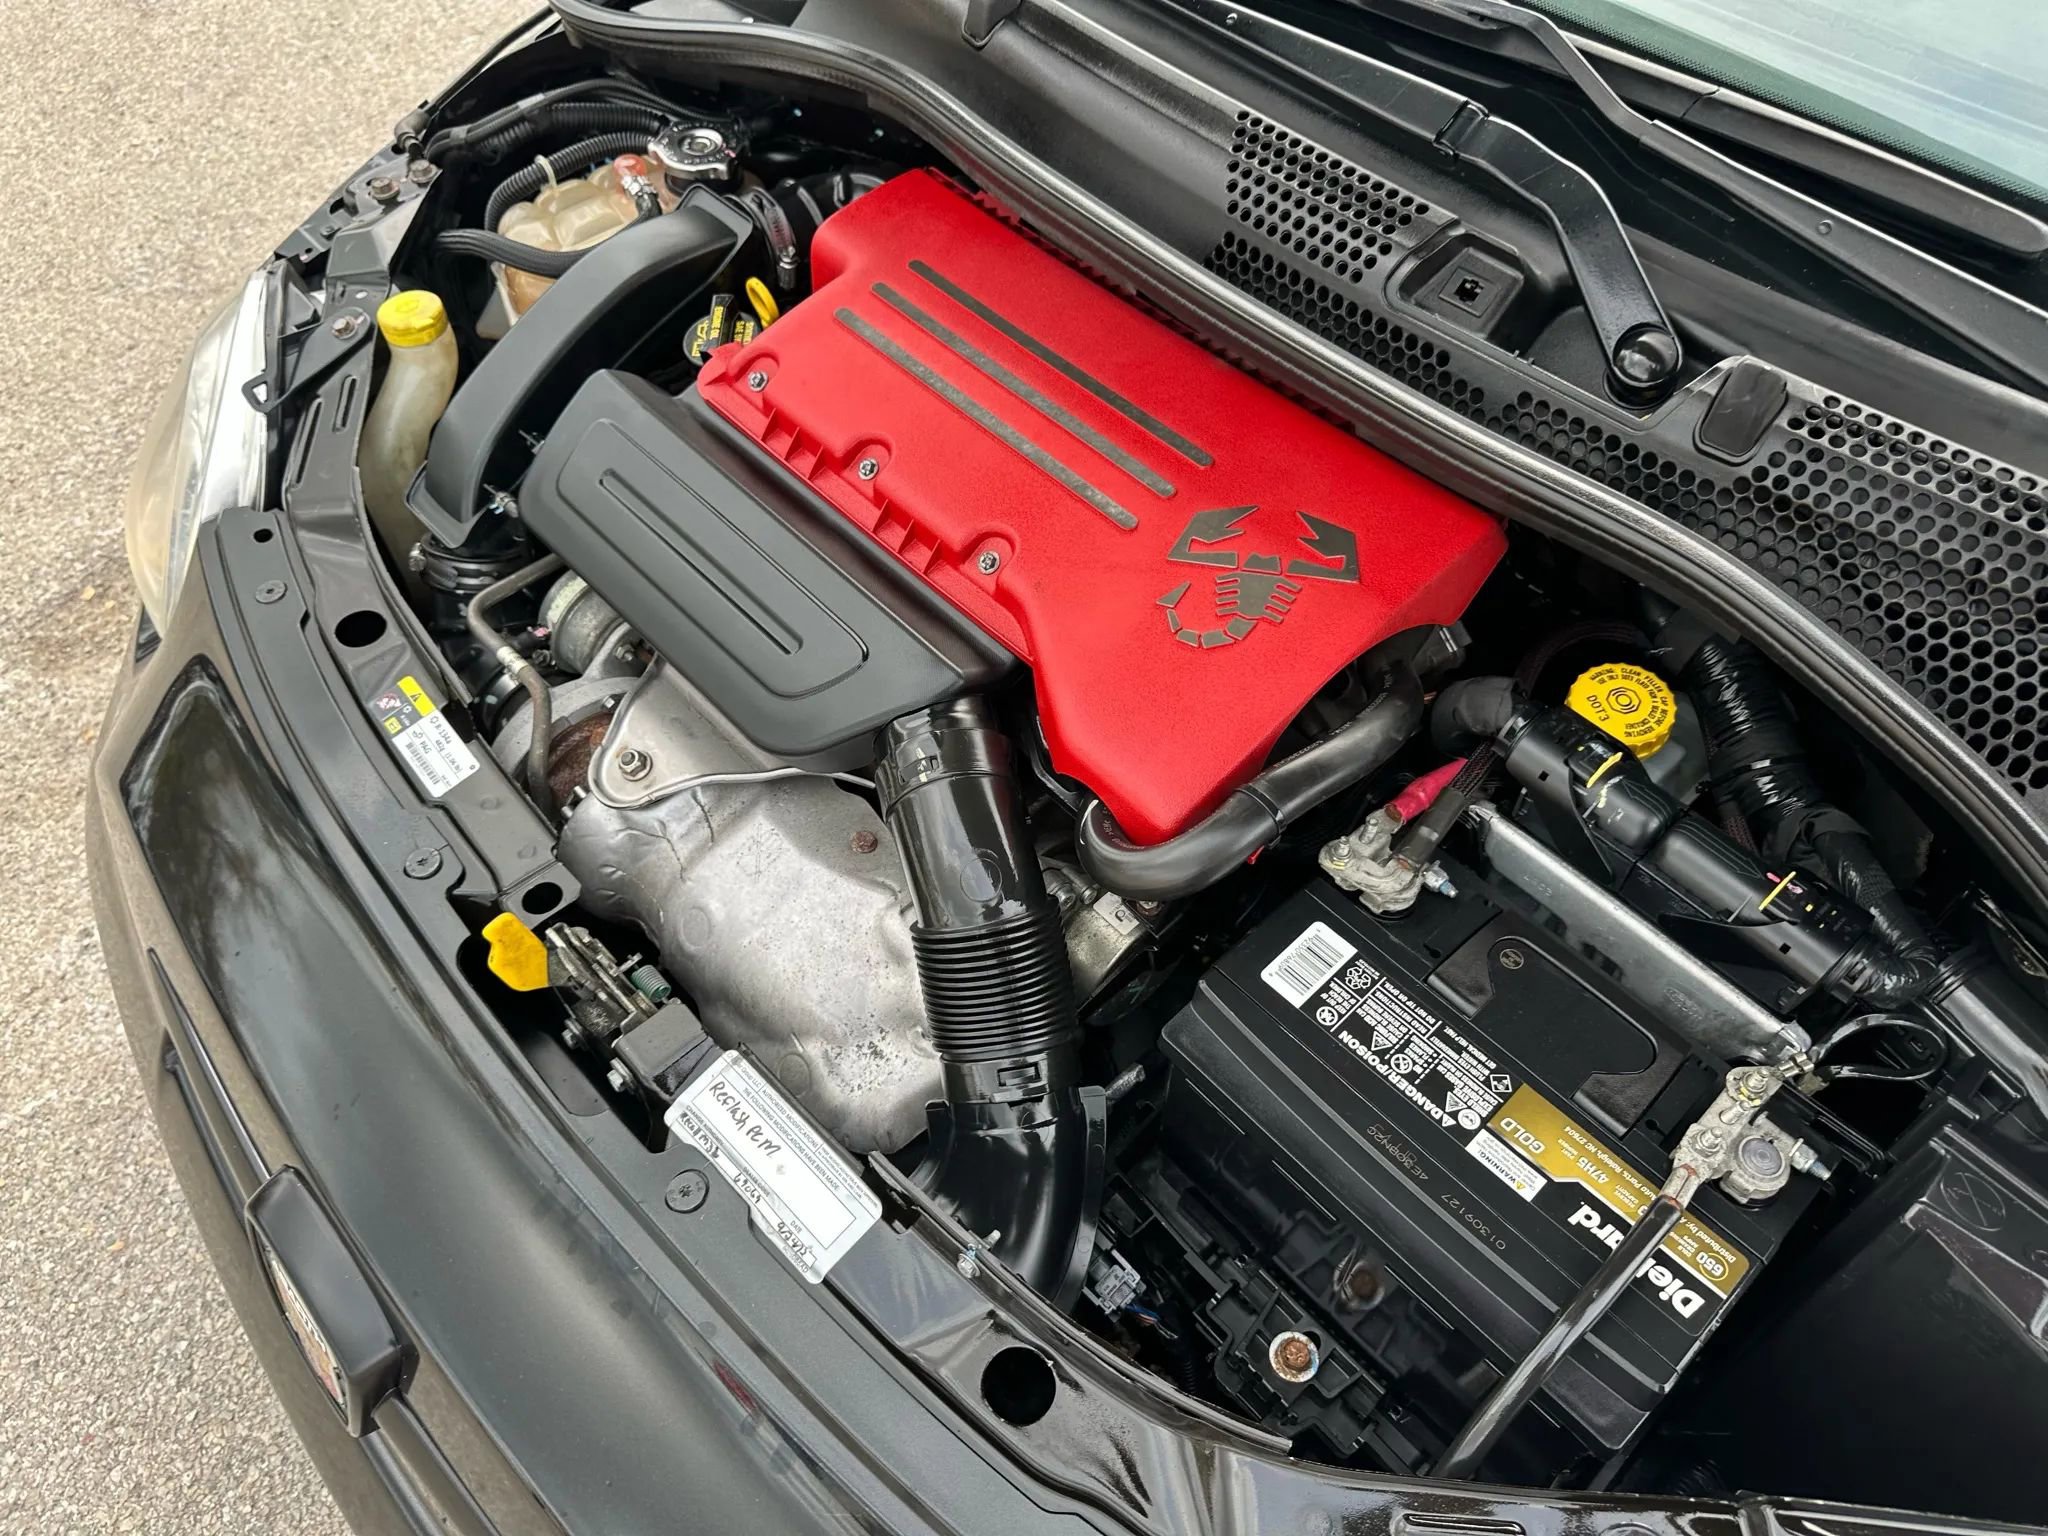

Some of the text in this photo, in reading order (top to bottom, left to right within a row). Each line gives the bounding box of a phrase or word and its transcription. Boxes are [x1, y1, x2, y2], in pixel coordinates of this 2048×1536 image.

[1410, 1018, 1427, 1034] READ
[1337, 1028, 1444, 1120] DANGER/POISON
[1498, 1114, 1546, 1156] GOLD
[1584, 1141, 1597, 1153] NC
[1575, 1154, 1611, 1186] 47H5
[789, 1220, 802, 1233] DATE
[1439, 1190, 1508, 1251] 01309127
[1695, 1228, 1737, 1264] Distributed
[1694, 1249, 1725, 1277] 650
